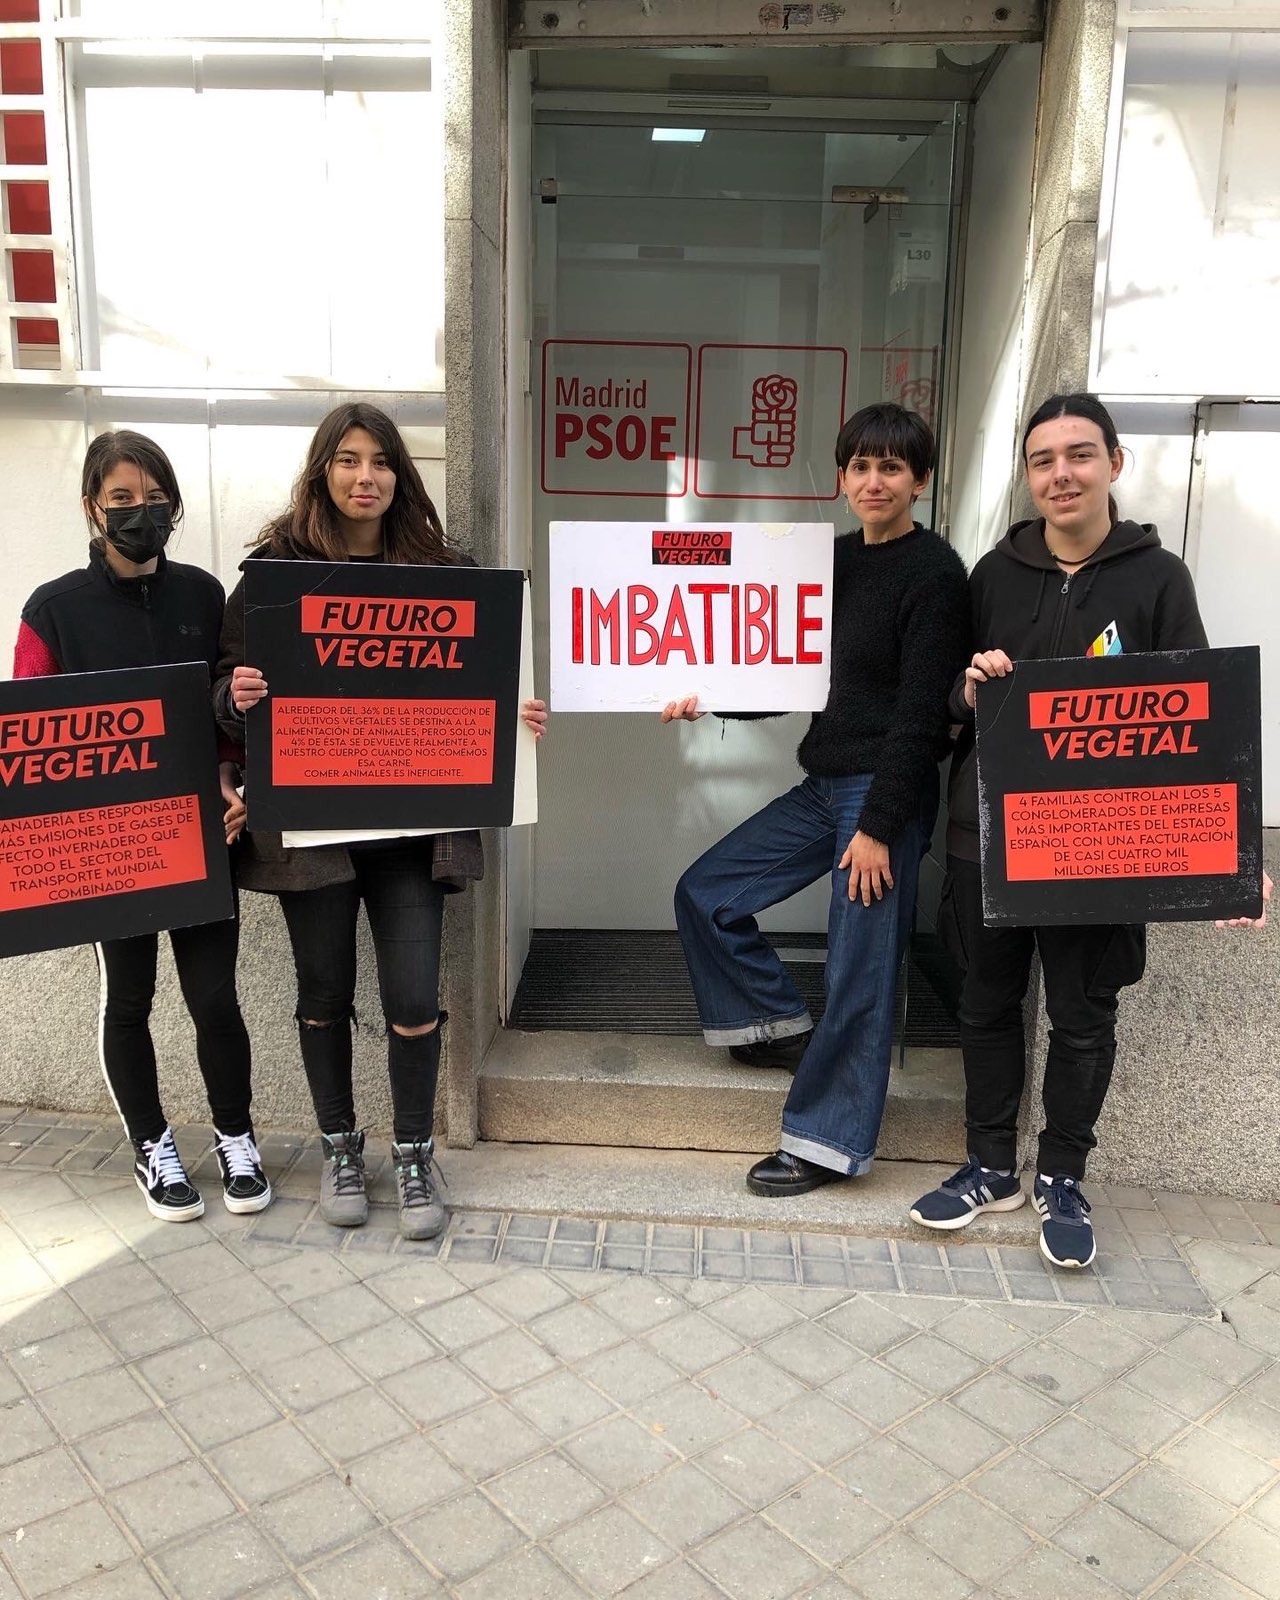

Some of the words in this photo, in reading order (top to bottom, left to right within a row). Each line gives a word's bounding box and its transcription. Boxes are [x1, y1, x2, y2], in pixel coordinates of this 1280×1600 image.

[907, 249, 931, 260] L30
[555, 376, 647, 409] Madrid
[555, 413, 677, 461] PSOE
[661, 533, 723, 547] FUTURO
[658, 550, 727, 564] VEGETAL
[321, 602, 457, 633] FUTURO
[571, 583, 823, 666] IMBATIBLE
[314, 638, 463, 669] VEGETAL
[277, 705, 337, 715] ALREDEDOR
[340, 706, 357, 715] DEL
[360, 706, 380, 715] 36%
[383, 706, 396, 715] DE
[397, 706, 410, 716] LA
[412, 705, 476, 716] PRODUCCIÓN
[478, 707, 490, 716] DE
[1049, 689, 1190, 724] FUTURO
[1, 707, 144, 748] FUTURO
[292, 716, 340, 725] CULTIVOS
[342, 716, 397, 726] VEGETALES
[399, 717, 411, 726] SE
[413, 717, 453, 726] DESTINA
[455, 718, 461, 726] A
[464, 718, 476, 726] LA
[276, 726, 350, 736] ALIMENTACIÓN
[352, 728, 365, 736] DE
[367, 727, 419, 737] ANIMALES,
[421, 728, 447, 736] PERO
[449, 728, 475, 736] SOLO
[478, 728, 491, 736] UN
[291, 738, 306, 746] 4%
[308, 738, 320, 747] DE
[323, 736, 346, 747] ÉSTA
[349, 738, 360, 747] SE
[363, 738, 411, 747] DEVUELVE
[413, 738, 468, 747] REALMENTE
[279, 748, 326, 757] NUESTRO
[328, 748, 368, 757] CUERPO
[371, 748, 413, 757] CUANDO
[415, 748, 436, 757] NOS
[438, 748, 488, 757] COMEMOS
[1043, 725, 1199, 760] VEGETAL
[0, 742, 158, 787] VEGETAL
[304, 769, 340, 778] COMER
[342, 769, 391, 778] ANIMALES
[394, 769, 405, 777] ES
[407, 768, 464, 777] INEFICIENTE.
[357, 759, 375, 767] ESA
[378, 759, 413, 767] CARNE.
[1019, 797, 1027, 807] 4
[1031, 794, 1090, 806] FAMILIAS
[1093, 790, 1179, 803] CONTROLAN
[1183, 788, 1210, 799] LOS
[1213, 788, 1221, 798] 5
[0, 812, 74, 834] ANADERÍA
[79, 811, 94, 823] ES
[98, 797, 194, 820] RESPONSABLE
[1011, 806, 1136, 820] CONGLOMERADOS
[1140, 805, 1157, 816] DE
[1161, 802, 1230, 815] EMPRESAS
[29, 825, 104, 845] EMISIONES
[108, 821, 126, 833] DE
[129, 815, 173, 830] GASES
[176, 812, 194, 824] DE
[1016, 822, 1045, 835] MÁS
[1049, 820, 1140, 834] IMPORTANTES
[1144, 819, 1169, 830] DEL
[1173, 817, 1226, 829] ESTADO
[48, 833, 148, 858] INVERNADERO
[151, 828, 180, 841] QUE
[1010, 836, 1068, 849] ESPAÑOL
[1072, 836, 1102, 847] CON
[1106, 835, 1135, 846] UNA
[1139, 829, 1233, 845] FACTURACIÓN
[13, 862, 55, 877] TODO
[60, 859, 75, 870] EL
[79, 850, 132, 867] SECTOR
[136, 846, 162, 859] DEL
[1054, 851, 1071, 861] DE
[1074, 850, 1104, 861] CASI
[1108, 848, 1162, 860] CUATRO
[1166, 847, 1189, 858] MIL
[10, 868, 102, 892] TRANSPORTE
[106, 859, 168, 878] MUNDIAL
[1054, 864, 1119, 876] MILLONES
[1123, 863, 1140, 873] DE
[1144, 861, 1189, 873] EUROS
[48, 878, 136, 900] COMBINADO
